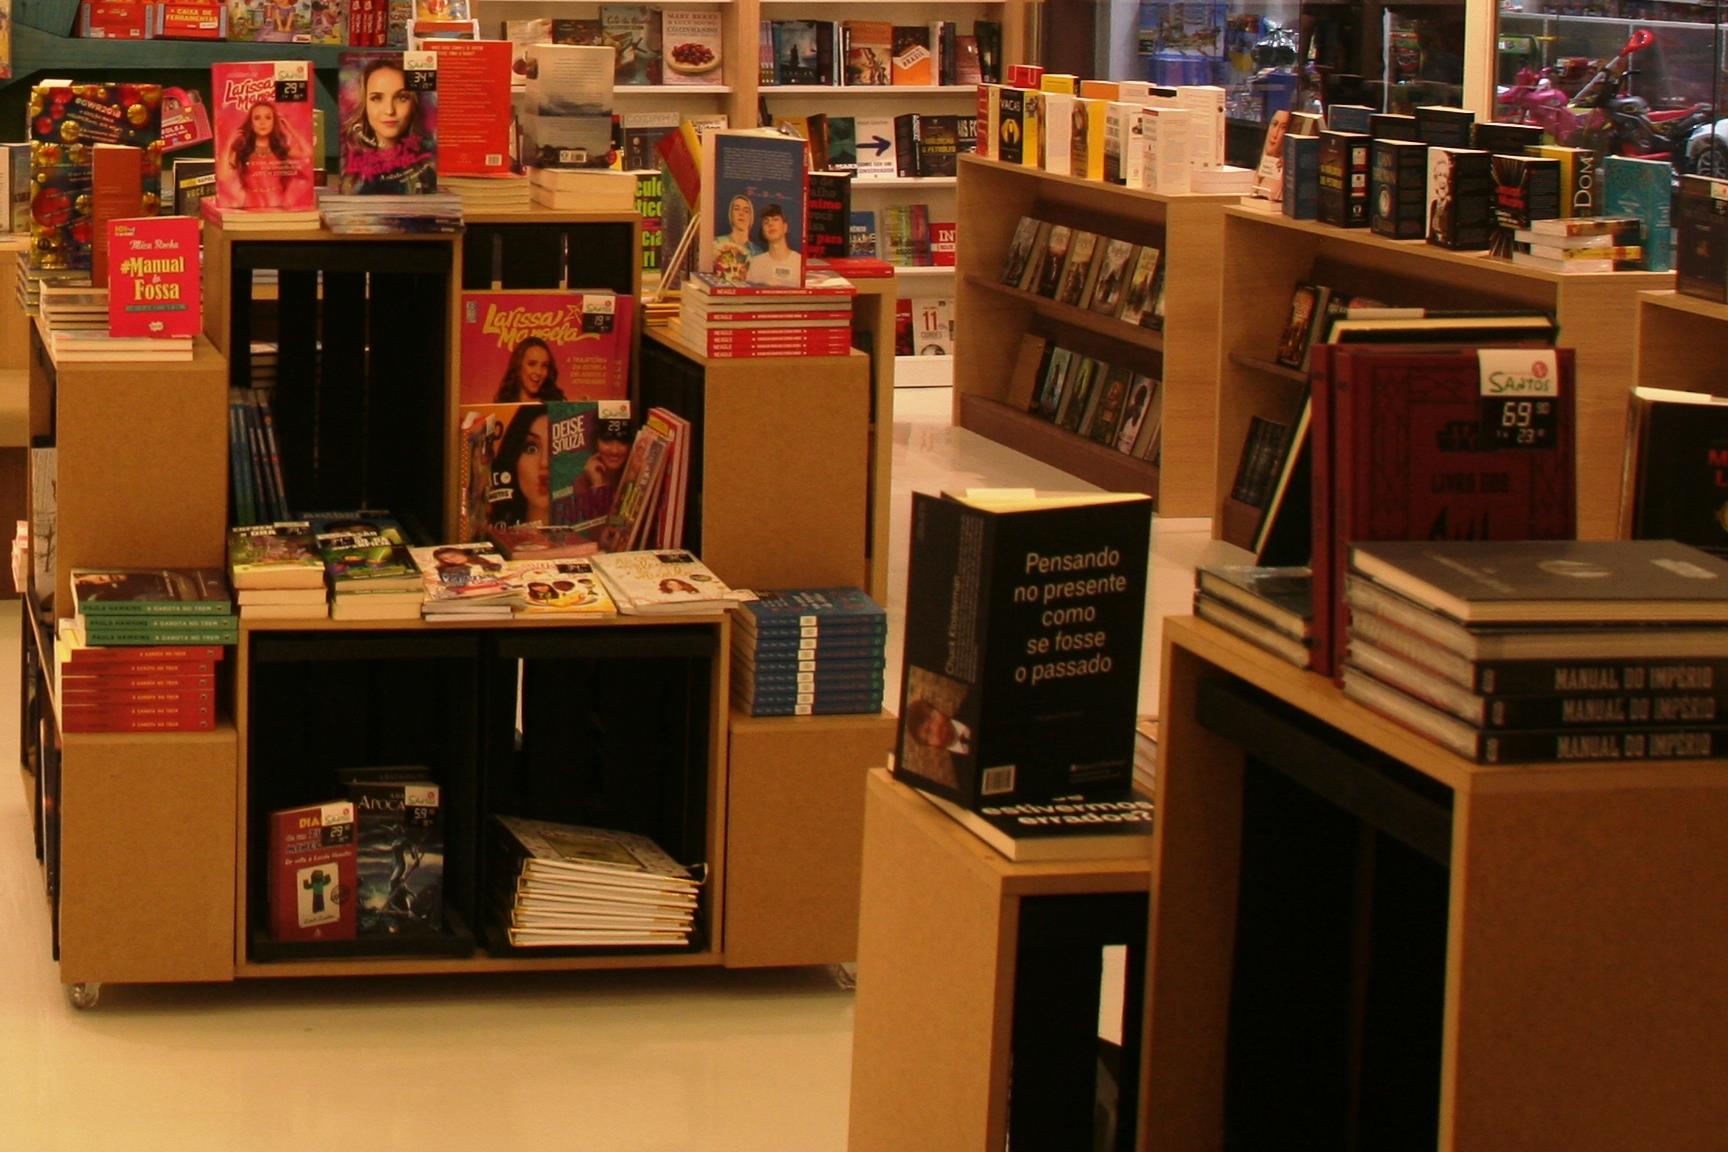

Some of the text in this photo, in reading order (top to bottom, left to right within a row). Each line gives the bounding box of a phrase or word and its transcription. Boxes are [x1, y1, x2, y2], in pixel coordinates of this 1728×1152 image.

[283, 82, 299, 94] 29
[412, 71, 428, 84] 34
[224, 79, 275, 105] Larissa
[1573, 154, 1595, 209] DOM
[120, 256, 185, 276] #Manual
[134, 278, 180, 301] Fossa
[483, 304, 560, 334] Larissa
[1488, 371, 1552, 394] SANTOS
[552, 414, 585, 440] DEISE
[1502, 401, 1533, 427] 69
[552, 433, 585, 456] SOUZA
[1025, 546, 1121, 575] Pensando
[1014, 573, 1127, 605] no presente
[944, 574, 962, 675] Chuck Klosterman
[1041, 605, 1096, 627] como
[1027, 628, 1107, 655] se fosse
[1015, 654, 1113, 686] o passado
[1554, 664, 1713, 690] MANUAL DO IMPÉRIO
[1562, 694, 1716, 722] MANUAL DO IMPÉRIO
[1556, 730, 1712, 759] MANUAL DO IMPÉRIO
[980, 798, 1154, 816] estivermos
[1017, 809, 1154, 826] errados?
